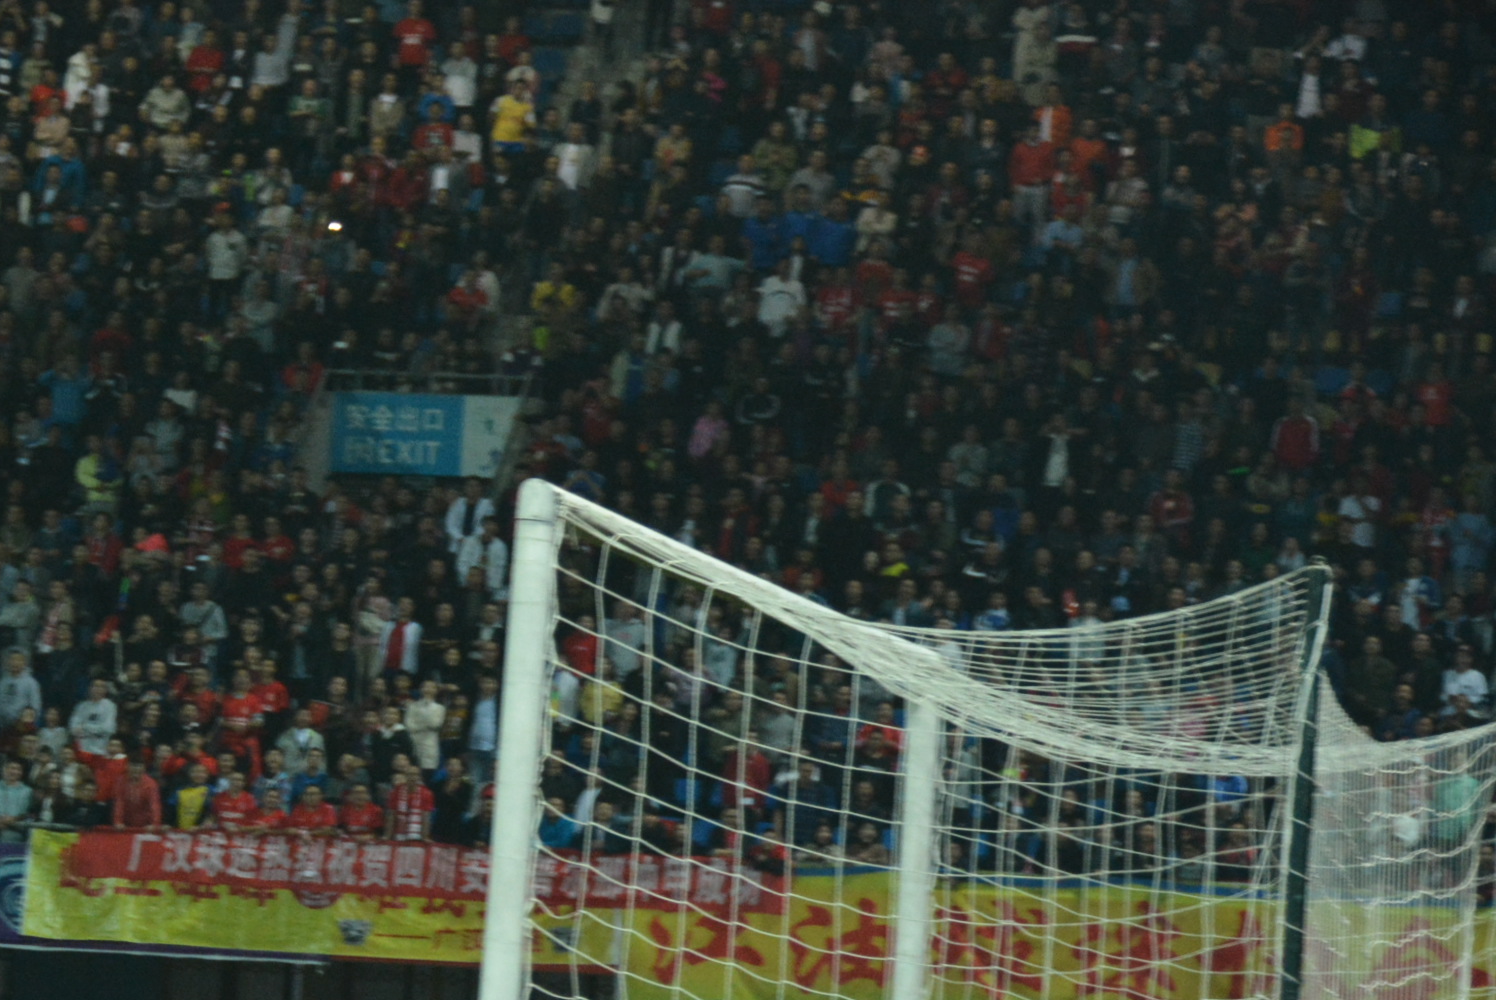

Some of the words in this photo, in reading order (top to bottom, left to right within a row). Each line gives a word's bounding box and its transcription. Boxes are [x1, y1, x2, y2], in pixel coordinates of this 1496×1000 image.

[345, 405, 444, 431] 安全出口
[378, 439, 441, 465] EXIT
